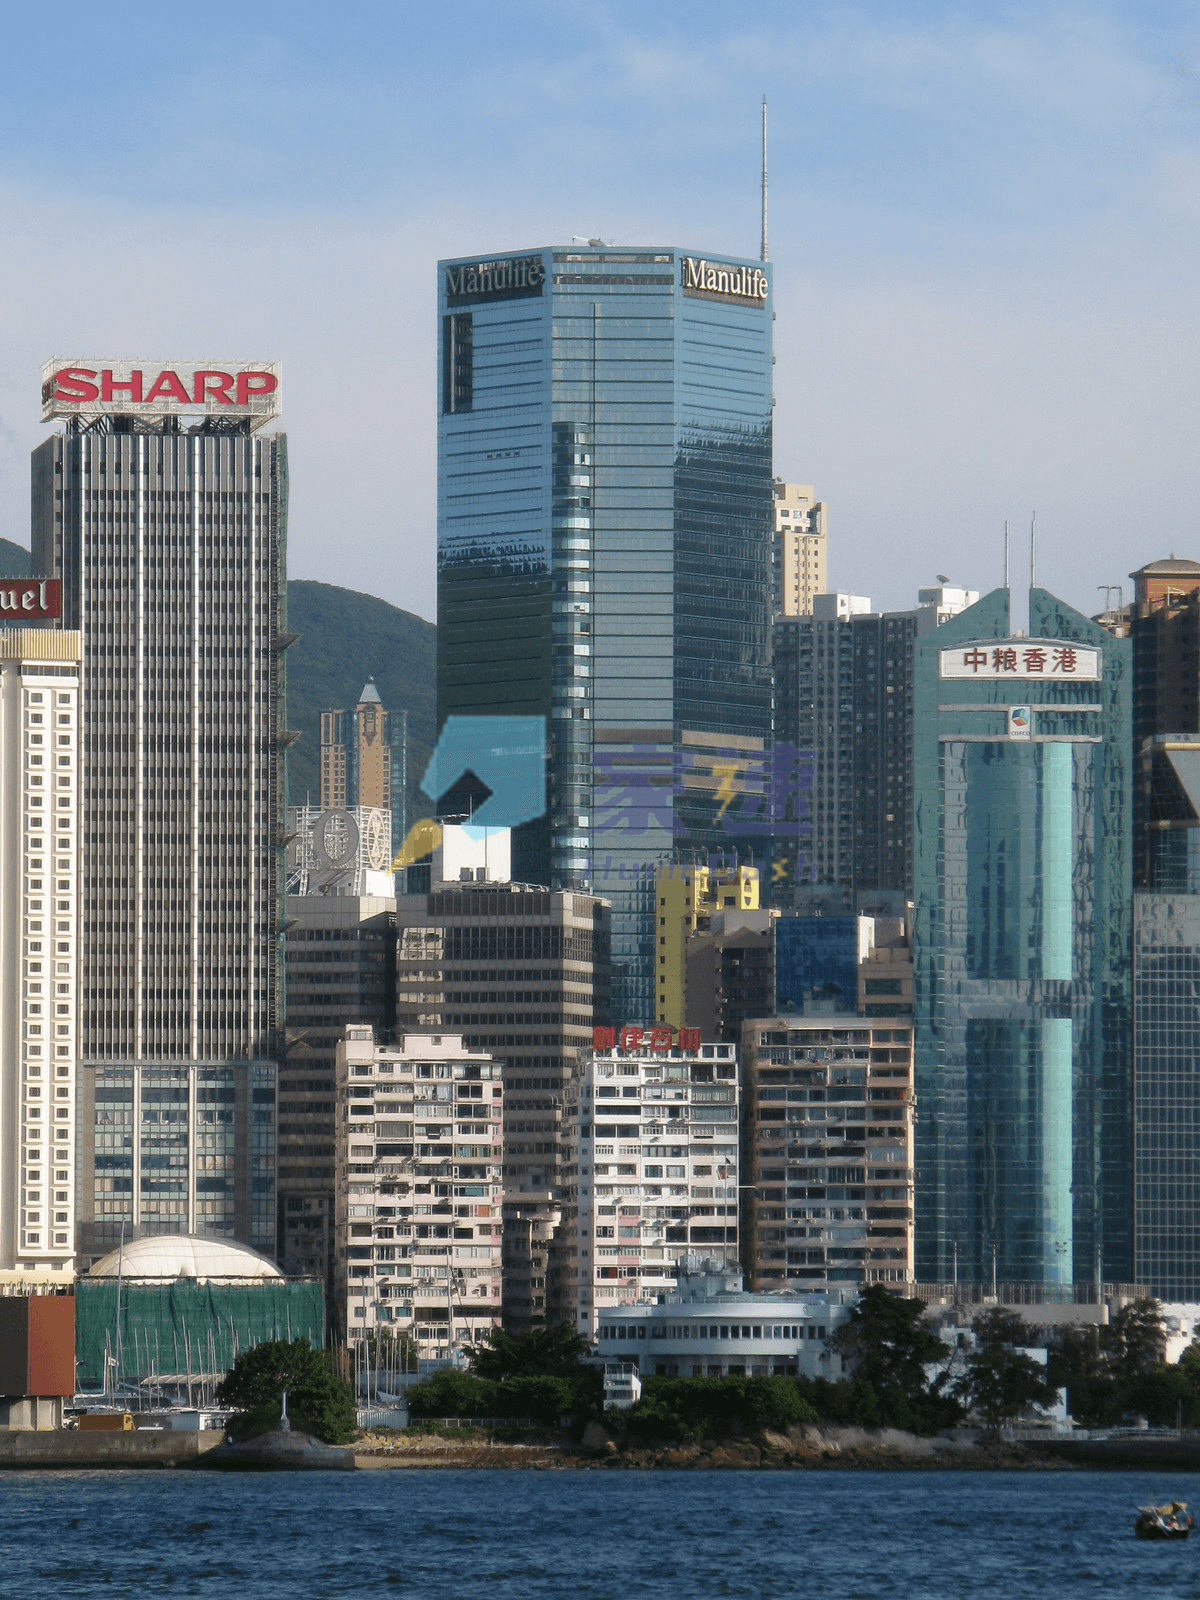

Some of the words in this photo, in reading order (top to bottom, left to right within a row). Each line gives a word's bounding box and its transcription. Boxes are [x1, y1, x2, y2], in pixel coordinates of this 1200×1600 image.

[444, 260, 541, 296] Manulife
[686, 257, 769, 298] Manulife
[54, 367, 278, 405] SHARP
[964, 646, 1078, 673] 中粮香港
